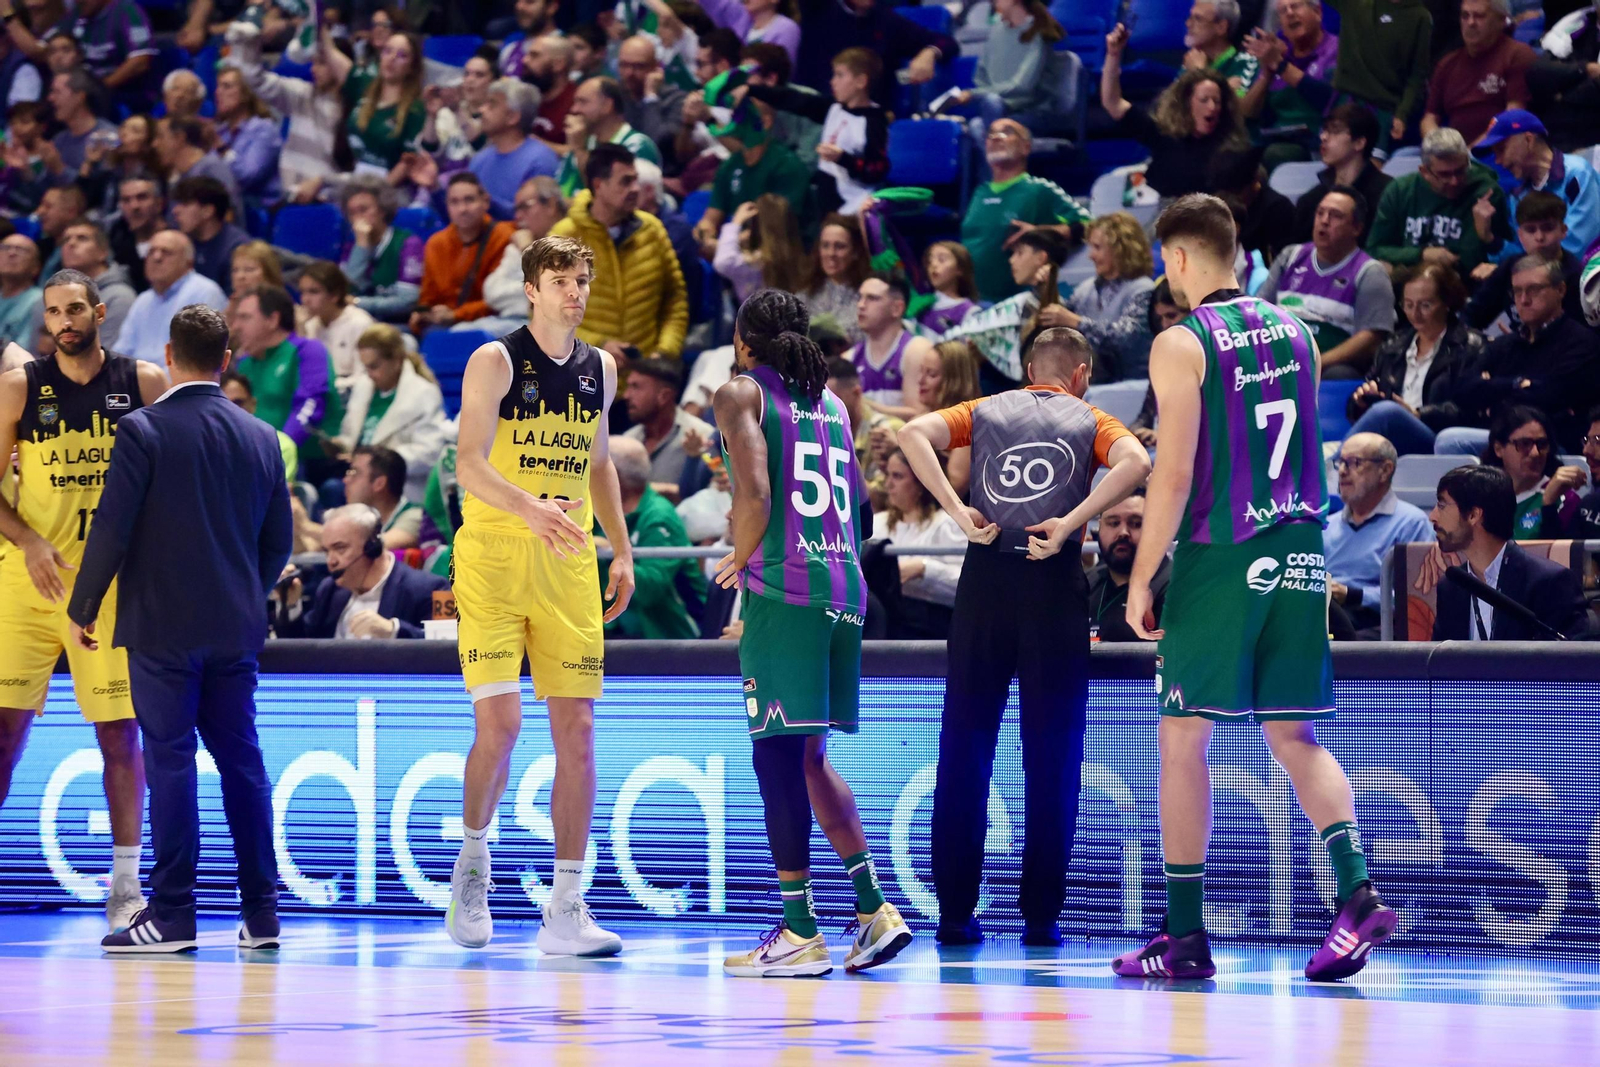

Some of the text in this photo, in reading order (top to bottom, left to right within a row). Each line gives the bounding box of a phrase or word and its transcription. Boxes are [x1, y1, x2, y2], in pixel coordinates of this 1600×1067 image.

[1213, 320, 1298, 351] Barreiro
[513, 430, 535, 446] LA
[1255, 398, 1297, 480] 7
[40, 450, 61, 466] LA
[791, 441, 851, 523] 55
[999, 454, 1055, 490] 50
[1281, 578, 1326, 593] MÁLAGA
[1284, 567, 1327, 581] DEL SOL
[562, 660, 599, 671] Canarias
[581, 655, 599, 664] Islas
[40, 698, 726, 915] edesa
[889, 755, 1600, 947] endes
